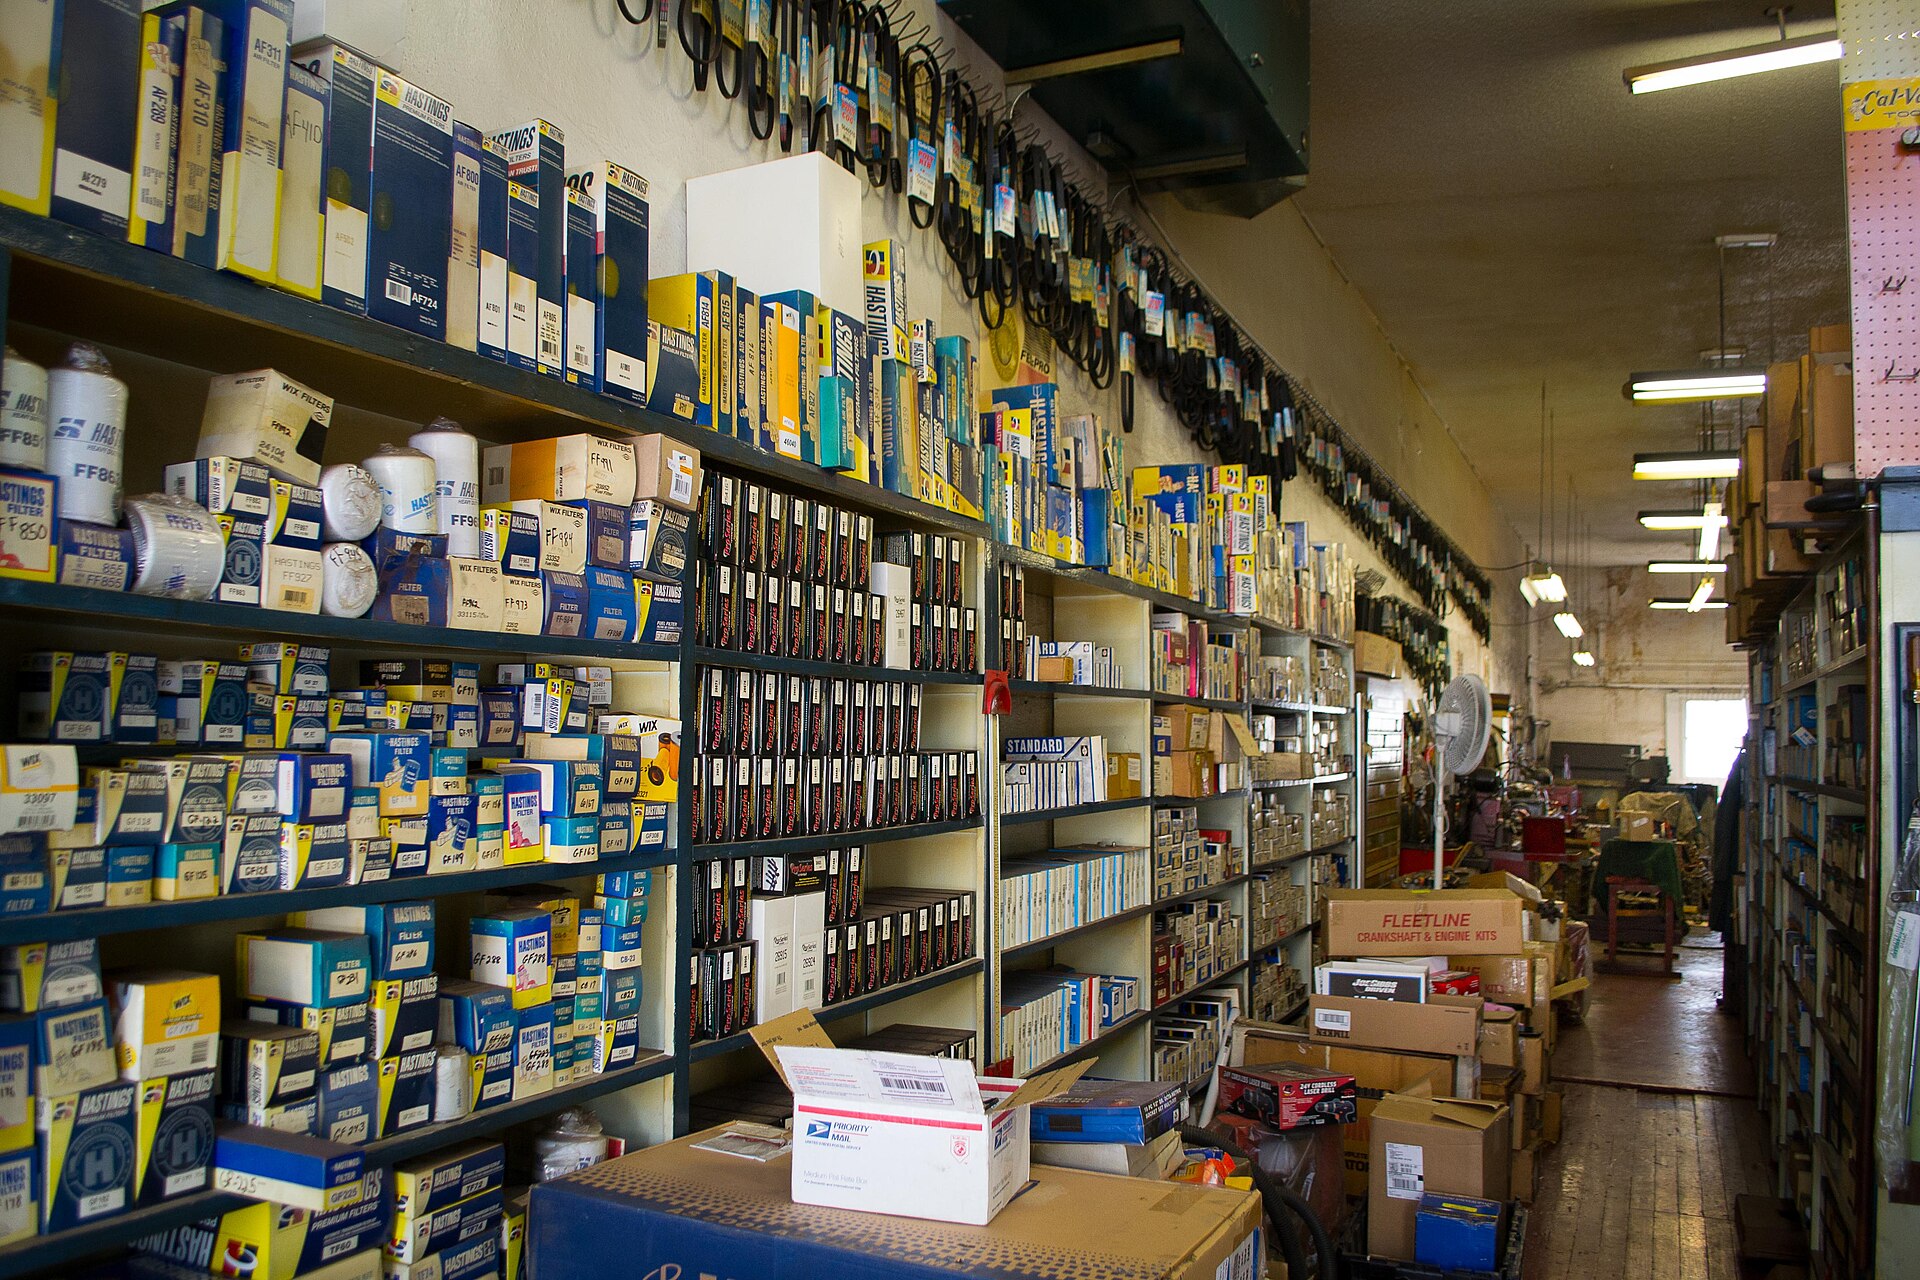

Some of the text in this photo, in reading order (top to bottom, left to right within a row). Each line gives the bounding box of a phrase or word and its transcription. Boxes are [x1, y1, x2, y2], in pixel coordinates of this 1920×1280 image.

[254, 38, 282, 63] AF311
[151, 85, 168, 125] AF289
[192, 78, 212, 127] AF310
[404, 85, 451, 122] HASTINGS
[402, 104, 425, 122] PREMIUM
[284, 109, 323, 145] AF410
[456, 163, 479, 186] AF800
[621, 171, 648, 195] HASTINGS
[411, 291, 438, 310] AF724
[701, 301, 711, 329] AF814
[722, 299, 730, 331] AF815
[661, 327, 695, 353] HASTINGS
[282, 382, 331, 414] WIX FILTERS
[597, 439, 632, 454] WIX FILTERS
[919, 412, 932, 471] HASTINGS
[933, 417, 946, 476] HASTINGS
[7, 503, 44, 518] FILTER
[549, 507, 585, 520] WIX FILTERS
[596, 506, 626, 524] HASTINGS
[663, 508, 690, 527] HASTINGS
[511, 514, 539, 531] HASTINGS
[19, 524, 48, 540] 850
[72, 527, 121, 548] HASTINGS
[603, 527, 620, 537] FILTER
[79, 546, 121, 561] FILTER
[102, 563, 124, 575] 855
[273, 557, 322, 571] HASTINGS
[459, 564, 499, 576] WIX FILTERS
[87, 574, 122, 589] FF855
[282, 571, 313, 583] FF927
[509, 578, 542, 590] WIX FILTERS
[553, 572, 583, 589] HASTINGS
[595, 572, 626, 590] HASTINGS
[398, 583, 423, 593] FILTER
[654, 583, 683, 599] HASTINGS
[559, 603, 578, 612] FILTER
[603, 607, 623, 617] FILTER
[494, 711, 511, 719] FILTER
[549, 696, 561, 732] HASTINGS
[617, 720, 629, 731] WIX
[639, 719, 658, 734] WIX
[394, 747, 413, 755] FILTER
[1007, 738, 1063, 754] STANDARD
[311, 763, 346, 779] HASTINGS
[615, 760, 633, 768] FILTER
[318, 777, 339, 786] FILTER
[579, 783, 596, 791] FILTER
[511, 794, 538, 810] HASTINGS
[447, 807, 464, 816] FILTER
[516, 808, 534, 817] FILTER
[605, 820, 624, 829] FILTER
[314, 825, 346, 841] HASTINGS
[573, 846, 596, 857] GF163
[394, 906, 432, 924] HASTINGS
[1382, 913, 1471, 928] FLEETLINE
[399, 930, 424, 941] FILTER
[1357, 931, 1497, 943] CRANKSHAFT & ENGINE KITS
[518, 935, 546, 953] HASTINGS
[336, 960, 361, 969] FILTER
[403, 977, 438, 997] HASTINGS
[1364, 985, 1396, 994] DRIVEN
[54, 1015, 101, 1039] HASTINGS
[492, 1020, 510, 1031] FILTER
[617, 1017, 638, 1033] HASTINGS
[73, 1028, 101, 1043] FILTER
[521, 1027, 549, 1044] HASTINGS
[531, 1039, 548, 1050] FILTER
[400, 1050, 437, 1071] HASTINGS
[487, 1051, 511, 1069] HASTINGS
[167, 1072, 215, 1100] HASTINGS
[1304, 1086, 1336, 1095] LASER DRILL
[1312, 1081, 1337, 1089] CORDLESS
[80, 1088, 133, 1118] HASTINGS
[338, 1106, 363, 1120] FILTER
[833, 1121, 870, 1133] PRIORITY
[831, 1133, 851, 1143] MAIL
[336, 1169, 356, 1183] FILTER
[434, 1163, 462, 1187] HASTINGS
[803, 1169, 828, 1180] Medium
[311, 1201, 379, 1232] PREMIUM FILTERS
[433, 1209, 461, 1234] HASTINGS
[443, 1248, 483, 1273] HASTINGS
